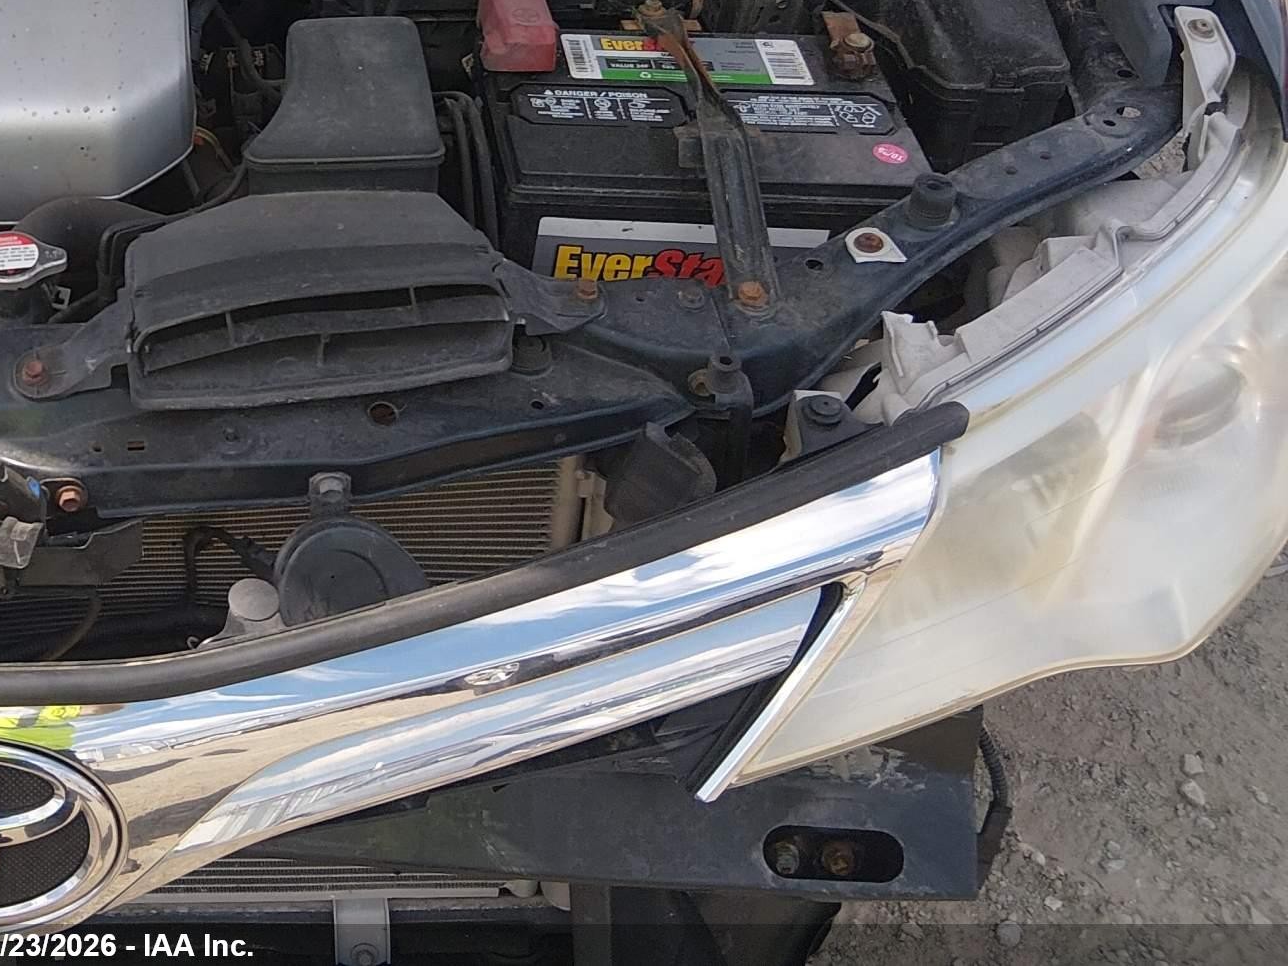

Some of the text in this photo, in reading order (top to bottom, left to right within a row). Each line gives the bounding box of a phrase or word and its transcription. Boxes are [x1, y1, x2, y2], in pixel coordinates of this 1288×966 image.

[554, 89, 598, 97] DANGER
[608, 91, 648, 99] POISON
[553, 244, 727, 287] EverSta
